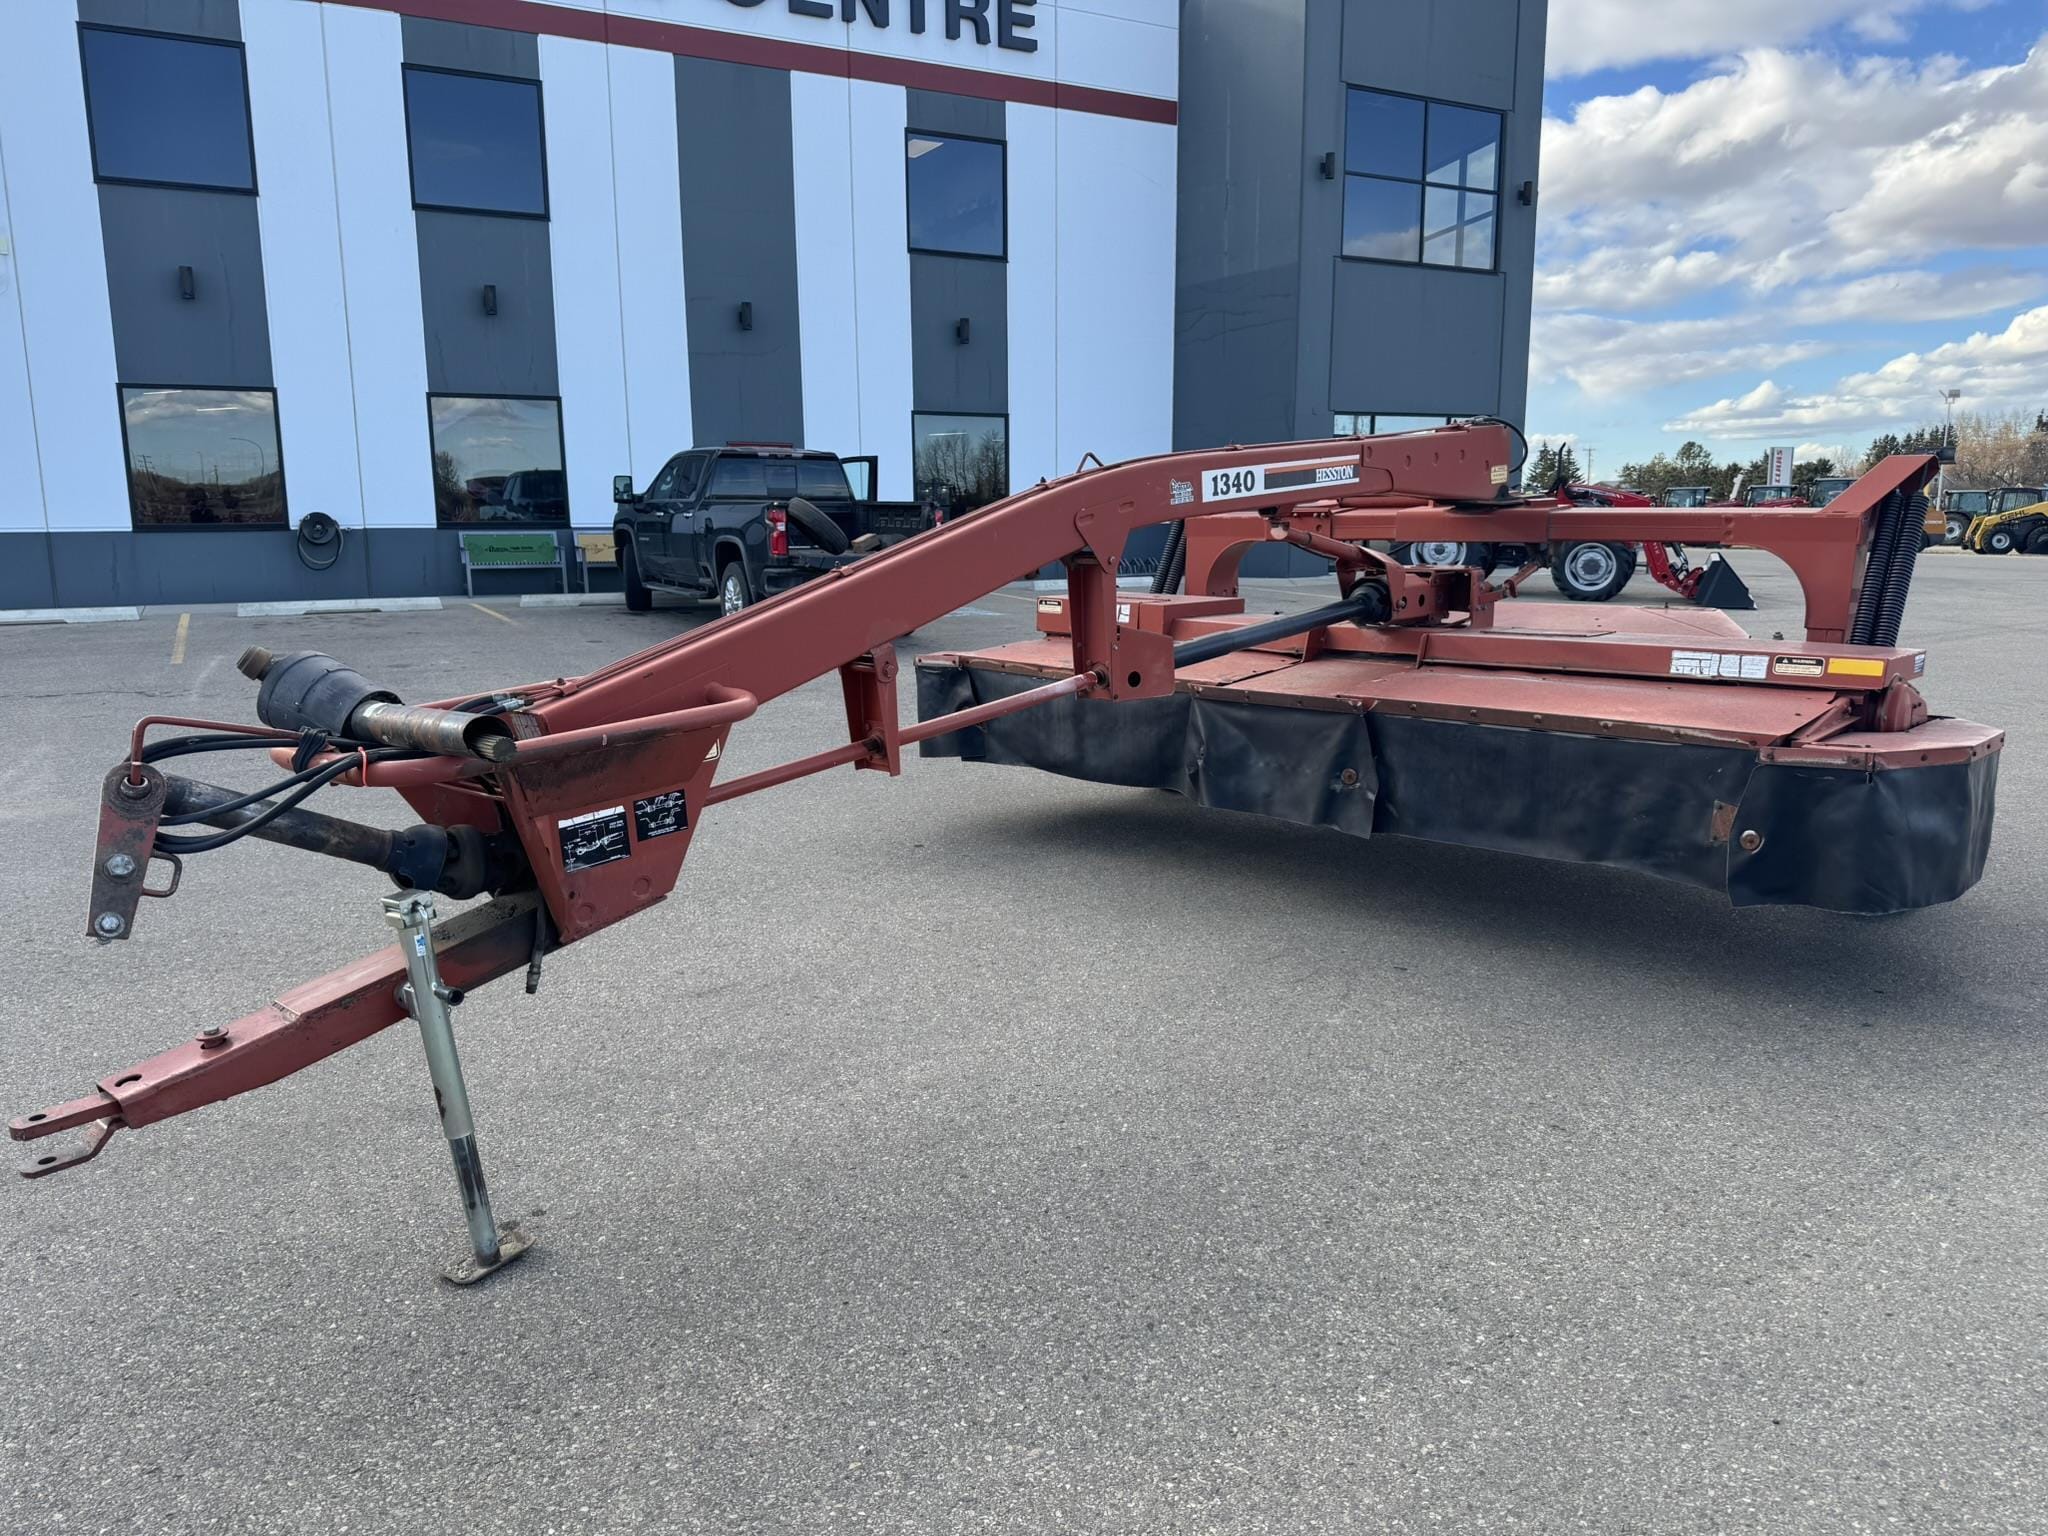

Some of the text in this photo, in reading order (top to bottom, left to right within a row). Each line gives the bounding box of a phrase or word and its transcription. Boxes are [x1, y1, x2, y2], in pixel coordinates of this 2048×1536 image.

[1212, 470, 1255, 496] 1340
[1315, 465, 1354, 483] HESSTON
[2000, 508, 2030, 521] GEHL
